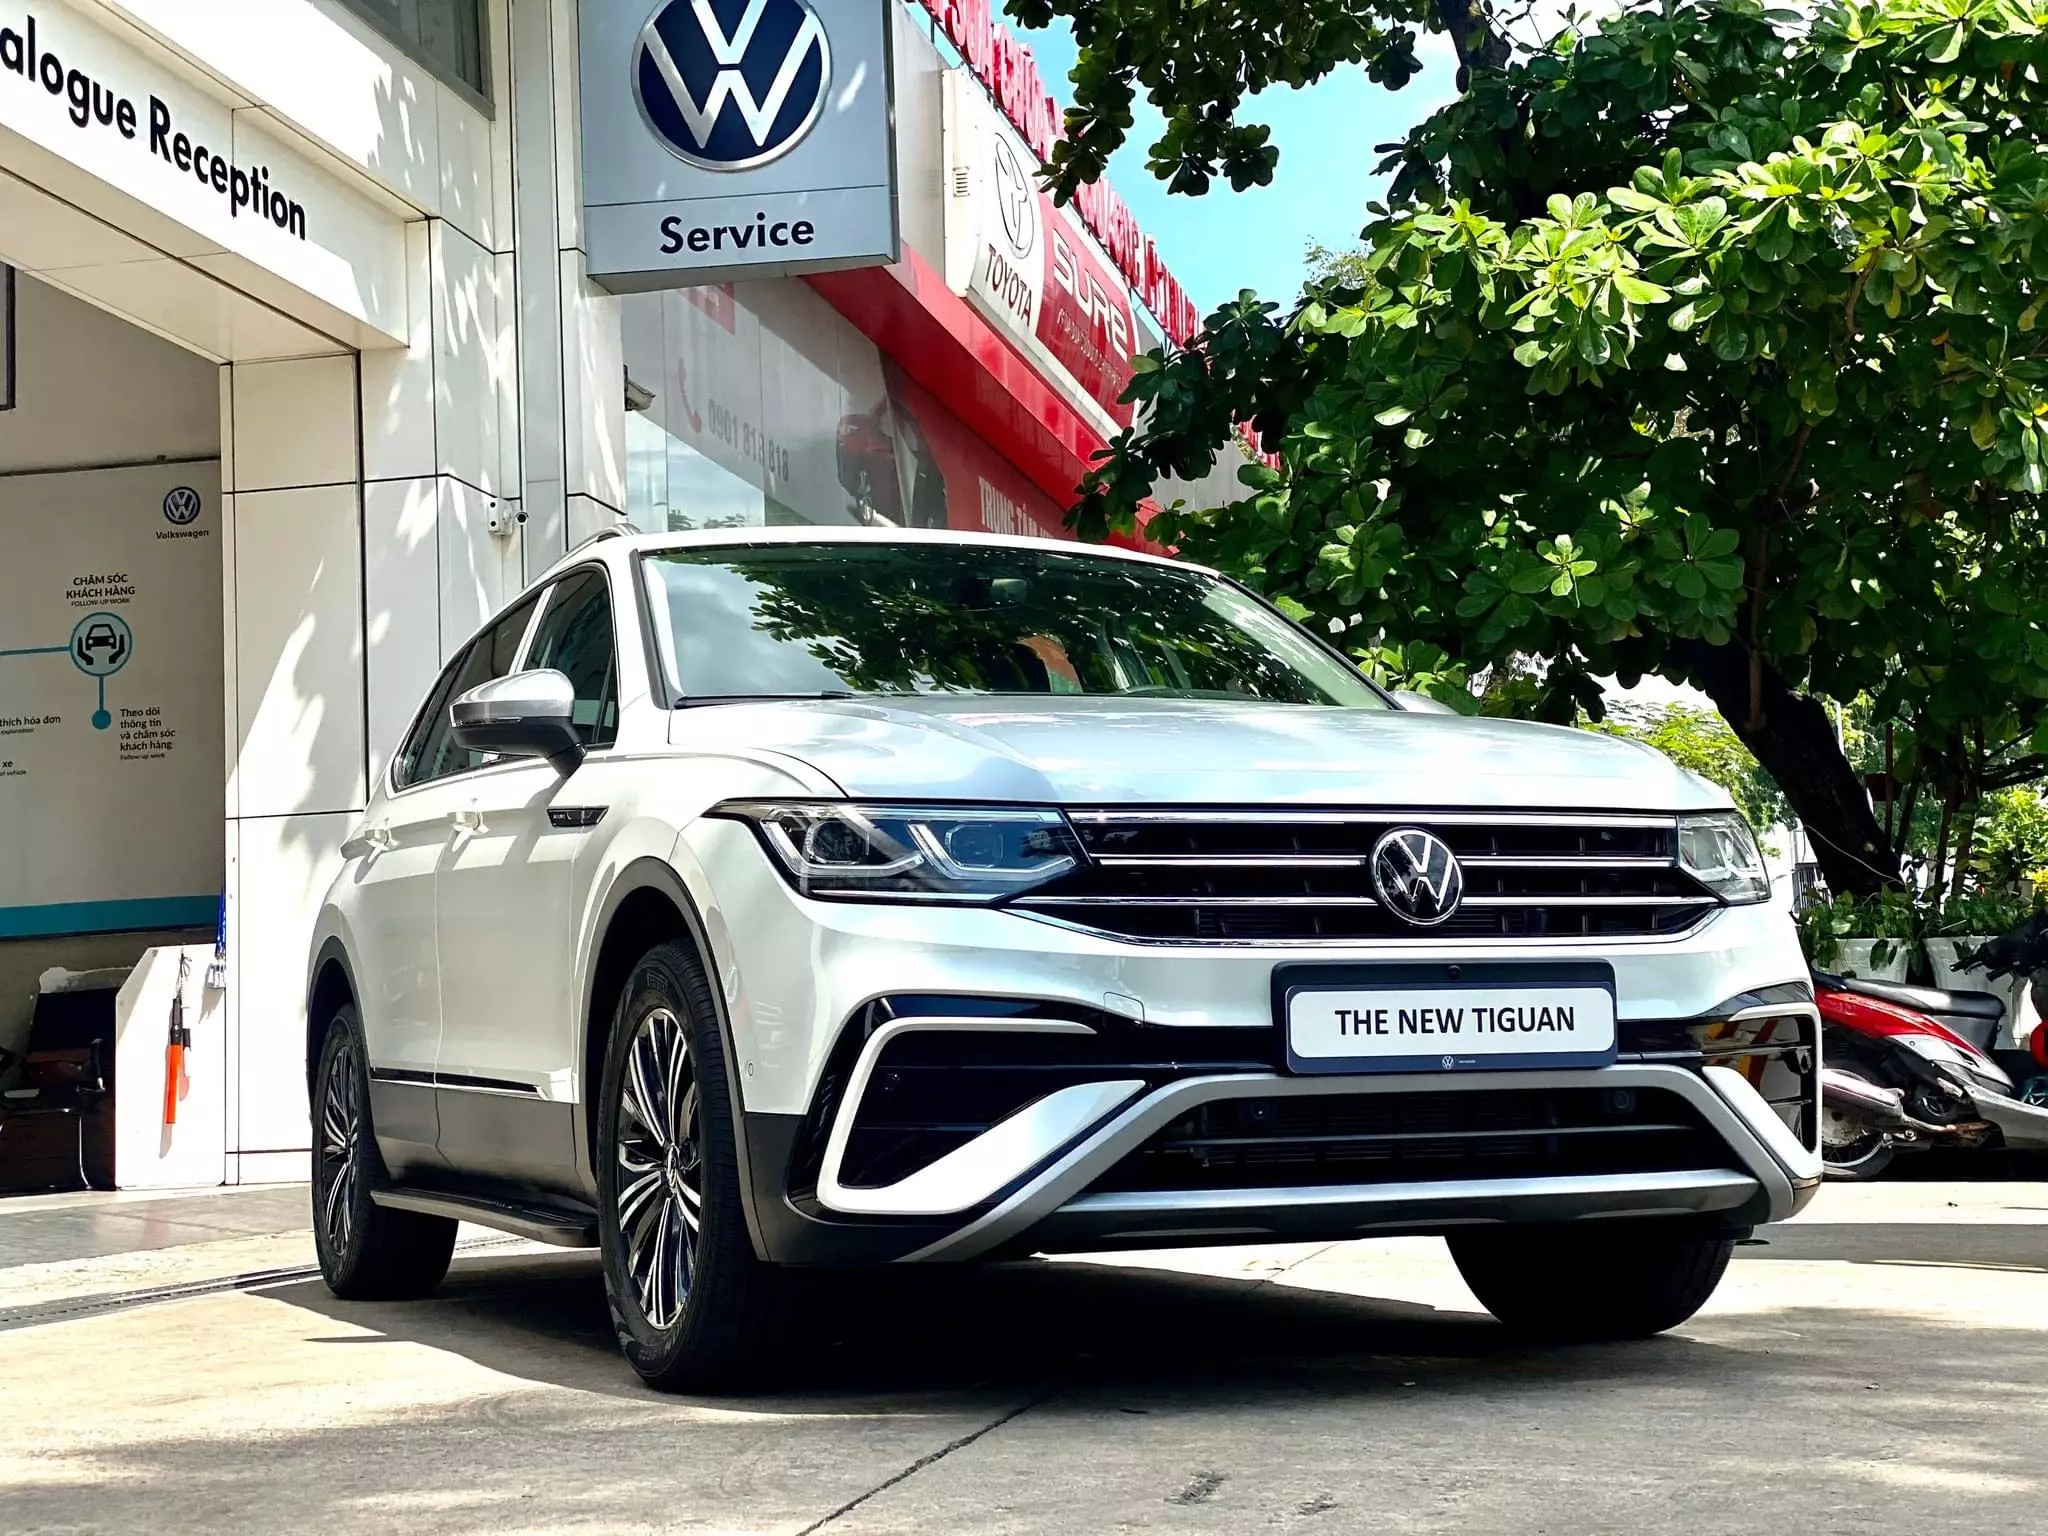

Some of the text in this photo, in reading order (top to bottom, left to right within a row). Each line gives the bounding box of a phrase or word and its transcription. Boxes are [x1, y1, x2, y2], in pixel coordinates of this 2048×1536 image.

[0, 15, 306, 240] alogue Reception
[660, 212, 815, 254] Service
[985, 243, 1032, 327] TOYOTA
[708, 399, 789, 482] 0901 818 818
[156, 530, 209, 540] Volkswagen
[73, 572, 129, 586] CHĂM SÓC
[66, 585, 136, 599] KHÁCH HÀNG
[120, 708, 144, 718] Theo
[120, 719, 147, 730] thông
[120, 731, 131, 740] và
[160, 728, 176, 738] sóc
[120, 740, 173, 752] khách hàng
[1334, 1006, 1575, 1036] THE NEW TIGUAN
